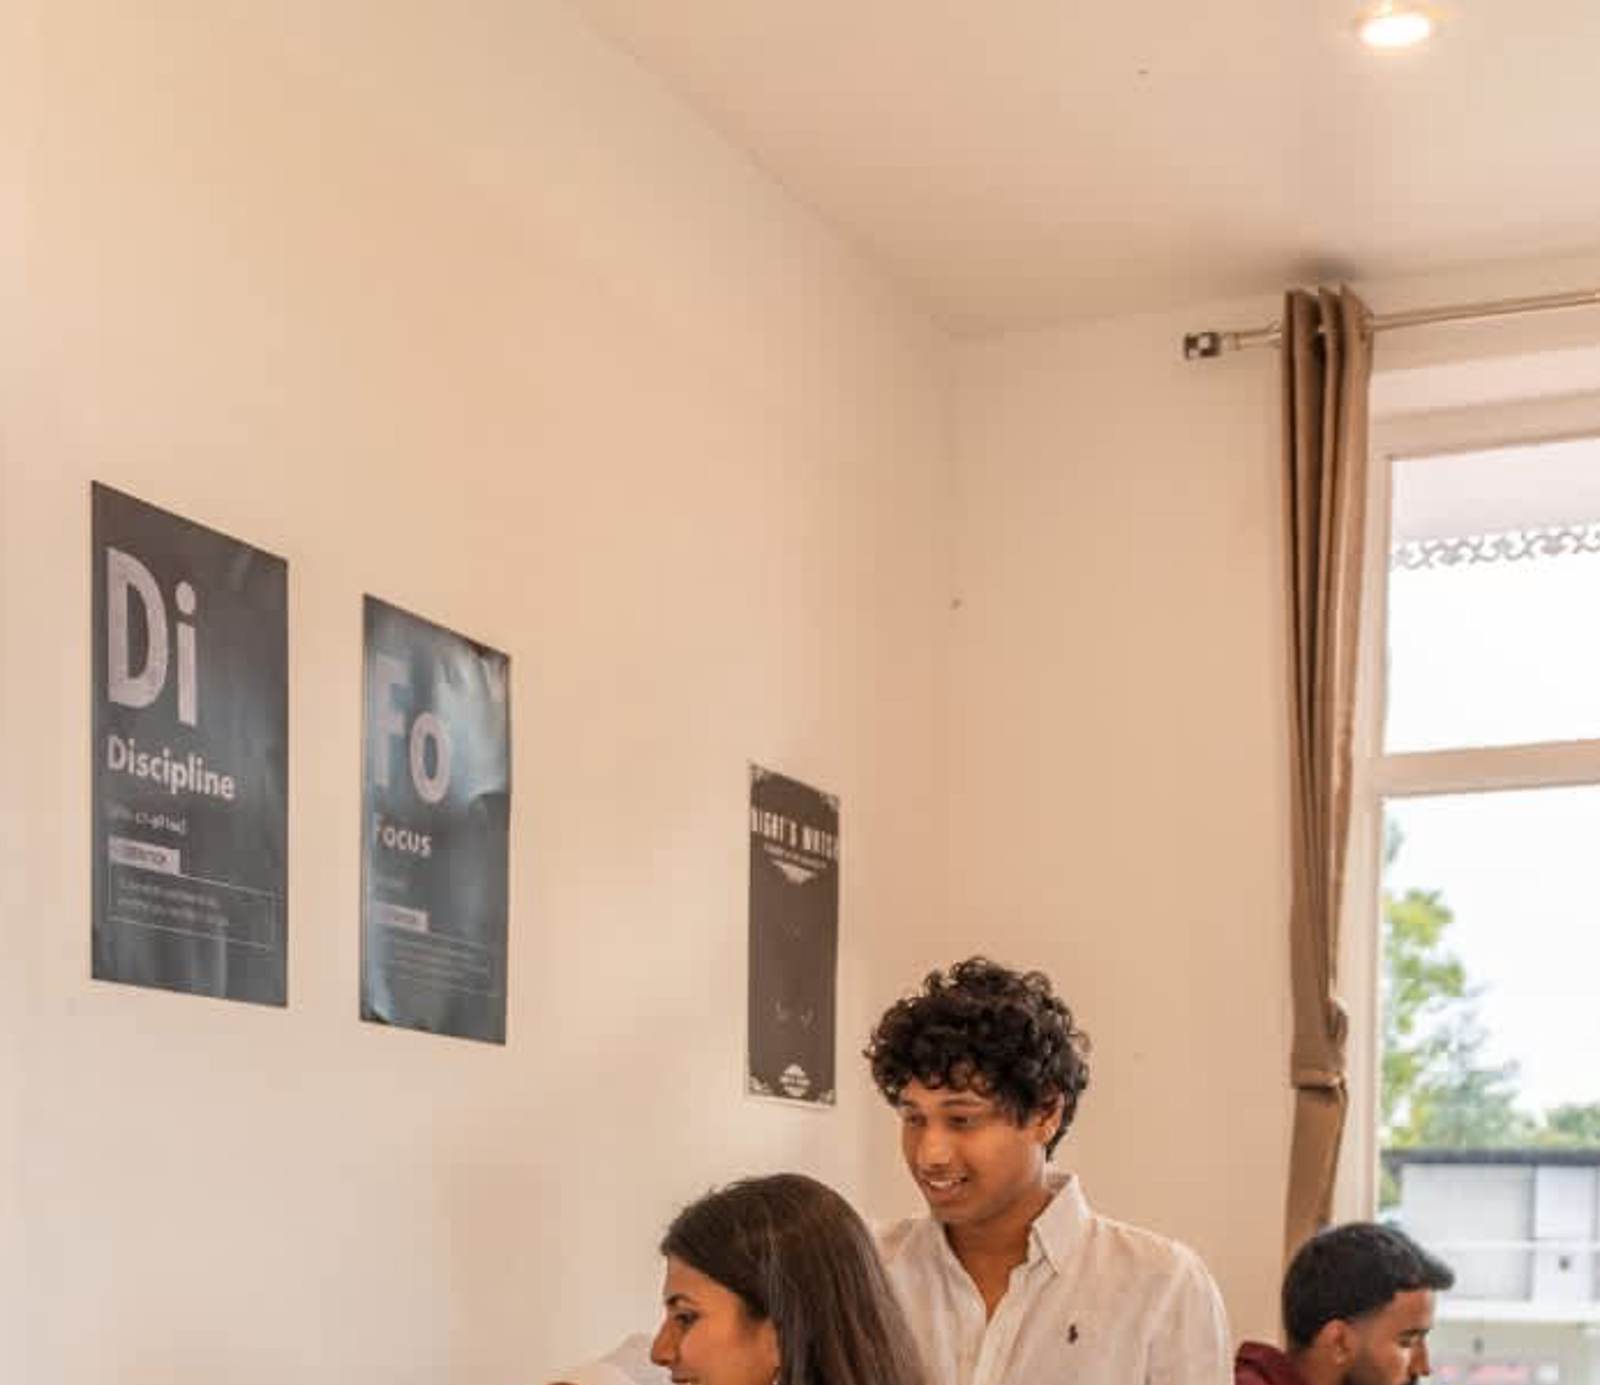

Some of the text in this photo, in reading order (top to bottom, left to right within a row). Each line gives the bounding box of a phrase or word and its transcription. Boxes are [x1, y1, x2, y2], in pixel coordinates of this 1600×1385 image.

[108, 547, 196, 726] Di
[107, 735, 235, 799] Discipline
[374, 653, 450, 803] Fo
[373, 812, 432, 857] Focus
